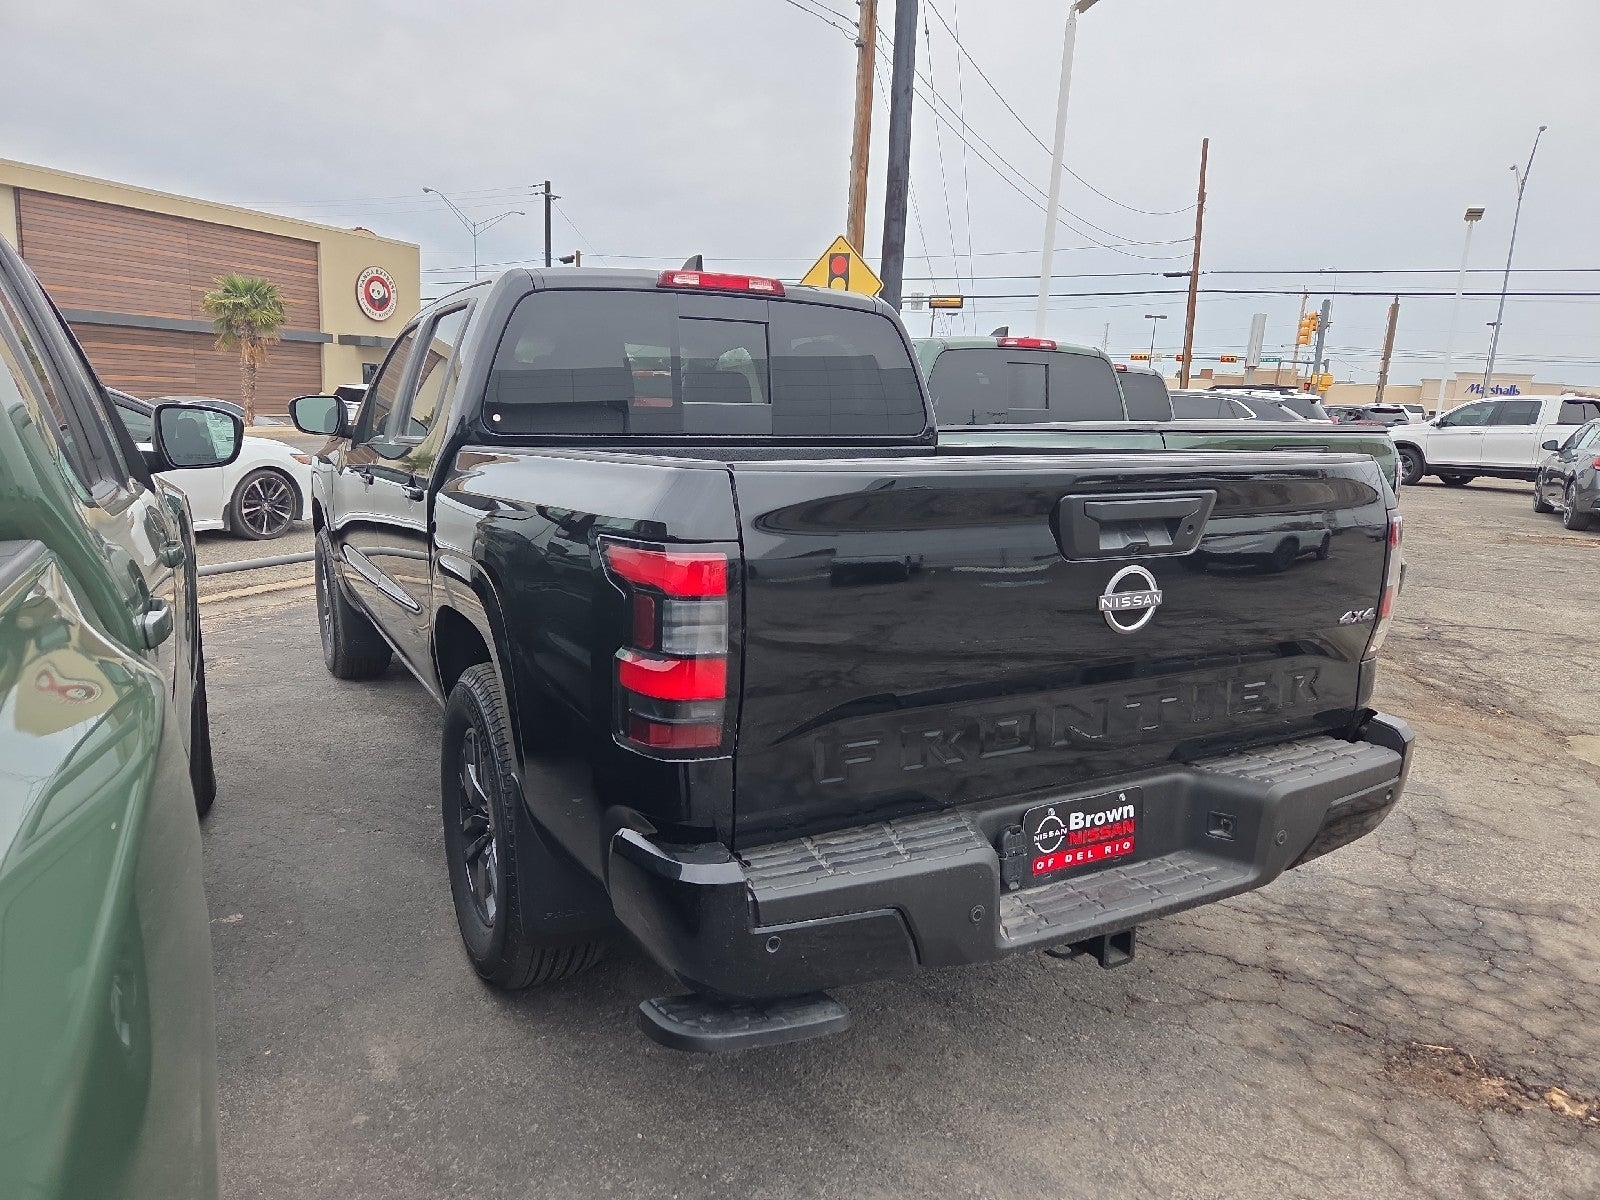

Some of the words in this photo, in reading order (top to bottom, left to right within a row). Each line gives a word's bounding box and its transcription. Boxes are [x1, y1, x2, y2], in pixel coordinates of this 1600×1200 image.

[359, 269, 375, 288] PANDA
[1464, 383, 1521, 396] Mashalls
[1101, 593, 1162, 609] NISSAN
[813, 666, 1321, 785] FRONTIER
[1069, 804, 1135, 831] Brown
[1033, 827, 1068, 843] NISSAN
[1067, 819, 1135, 846] NISSAN
[1036, 857, 1055, 870] OF
[1064, 850, 1094, 863] DEL
[1104, 841, 1131, 855] RIO
